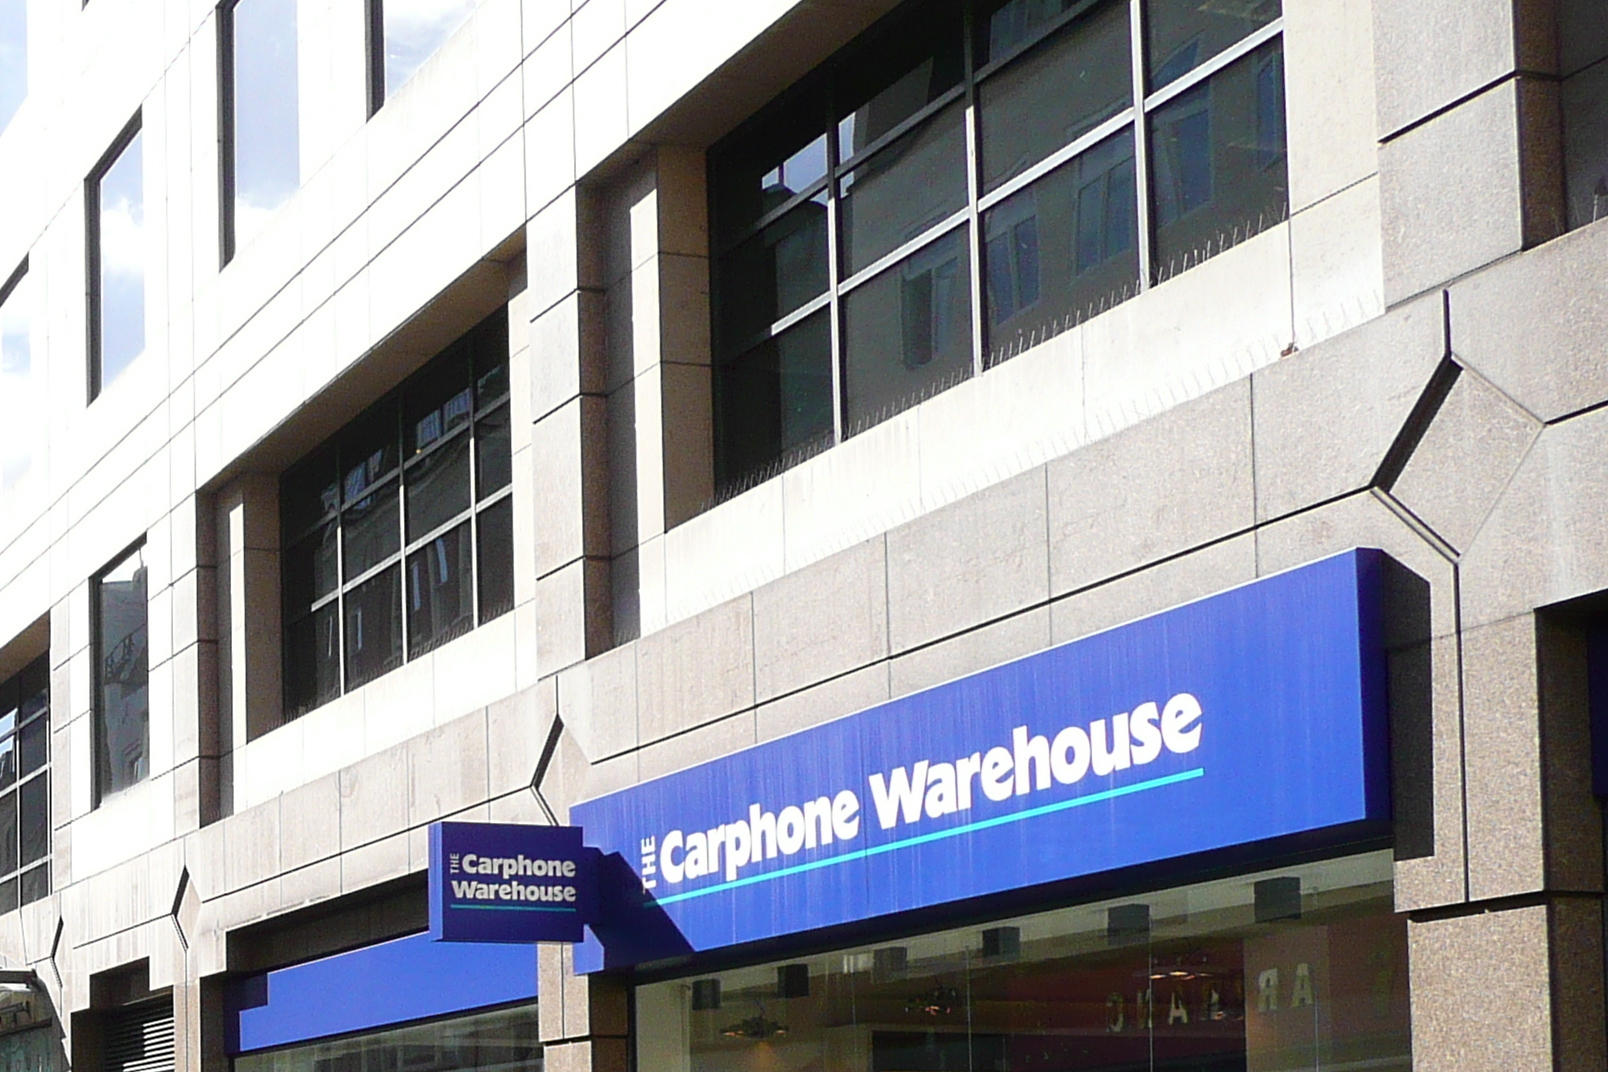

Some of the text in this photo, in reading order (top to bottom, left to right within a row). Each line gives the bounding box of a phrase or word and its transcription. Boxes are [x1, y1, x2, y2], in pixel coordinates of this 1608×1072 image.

[641, 692, 1204, 890] THE Carphone Warehouse
[450, 852, 576, 879] THE Carphone
[451, 880, 577, 901] Warehouse
